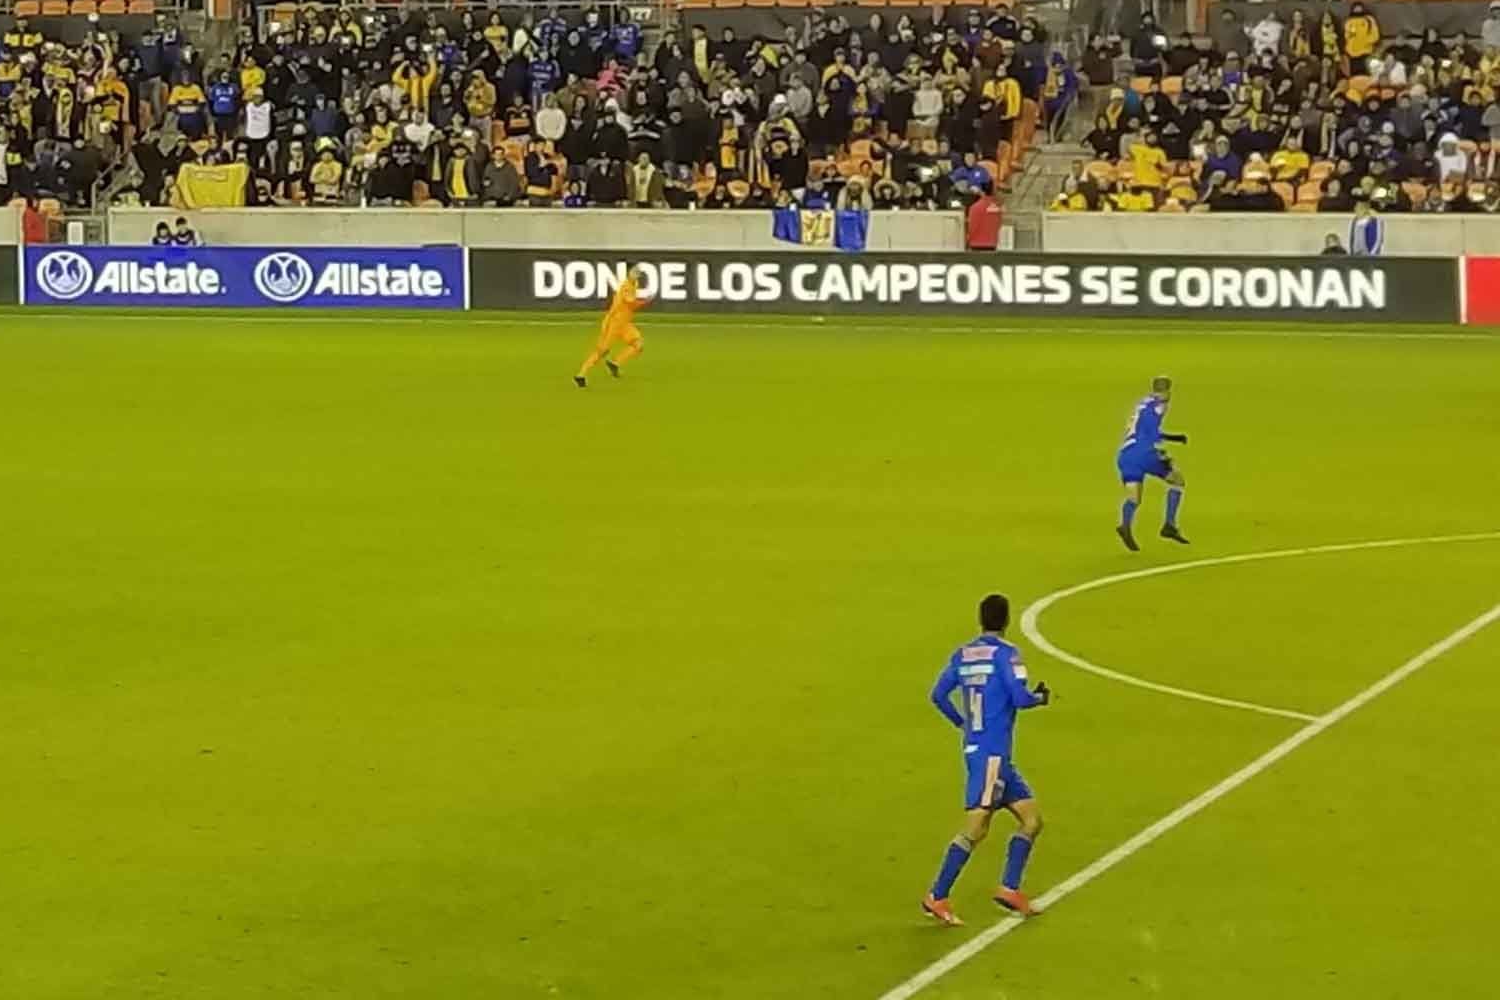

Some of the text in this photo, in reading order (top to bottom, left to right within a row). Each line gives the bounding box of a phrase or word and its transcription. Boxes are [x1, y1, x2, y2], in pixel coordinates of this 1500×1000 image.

[696, 262, 782, 301] LOS
[790, 263, 1072, 303] CAMPEONES
[1079, 266, 1140, 305] SE
[1149, 266, 1386, 308] CORONAN
